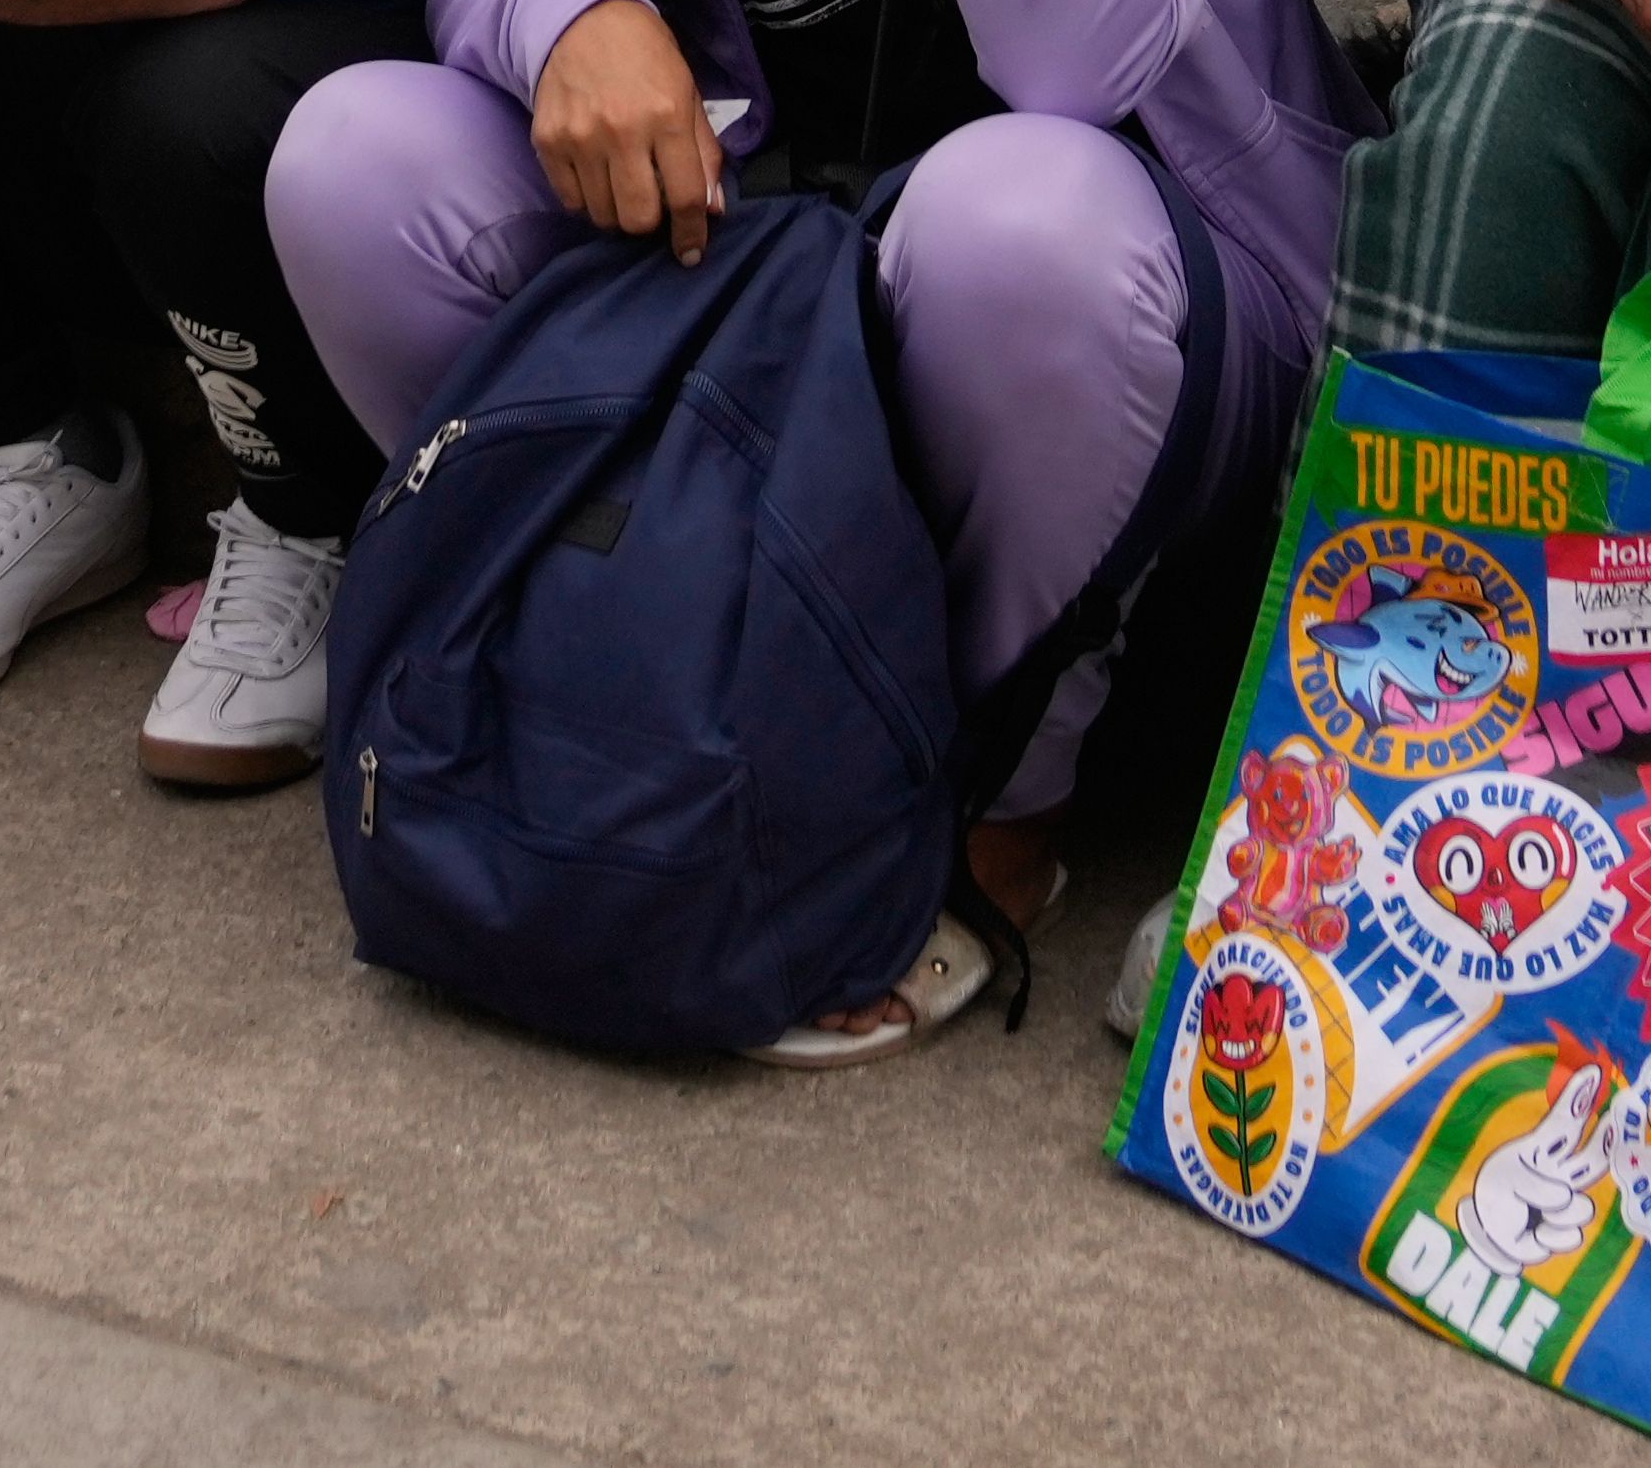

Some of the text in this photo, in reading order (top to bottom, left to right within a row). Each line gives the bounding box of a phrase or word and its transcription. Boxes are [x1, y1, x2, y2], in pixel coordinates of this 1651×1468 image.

[1350, 431, 1568, 532] TU PUEDES
[1303, 536, 1368, 604] TODO
[1370, 527, 1411, 558] ES
[1421, 531, 1531, 640] POSIBLE
[1296, 650, 1527, 770] TODO ES POSIBLE
[1383, 807, 1434, 866] AMA
[1435, 788, 1470, 819] LO
[1481, 782, 1535, 811] QUE
[1382, 894, 1615, 982] HAZ LO QUE AMAS
[1623, 1107, 1642, 1143] TU
[1386, 1211, 1561, 1373] DALE
